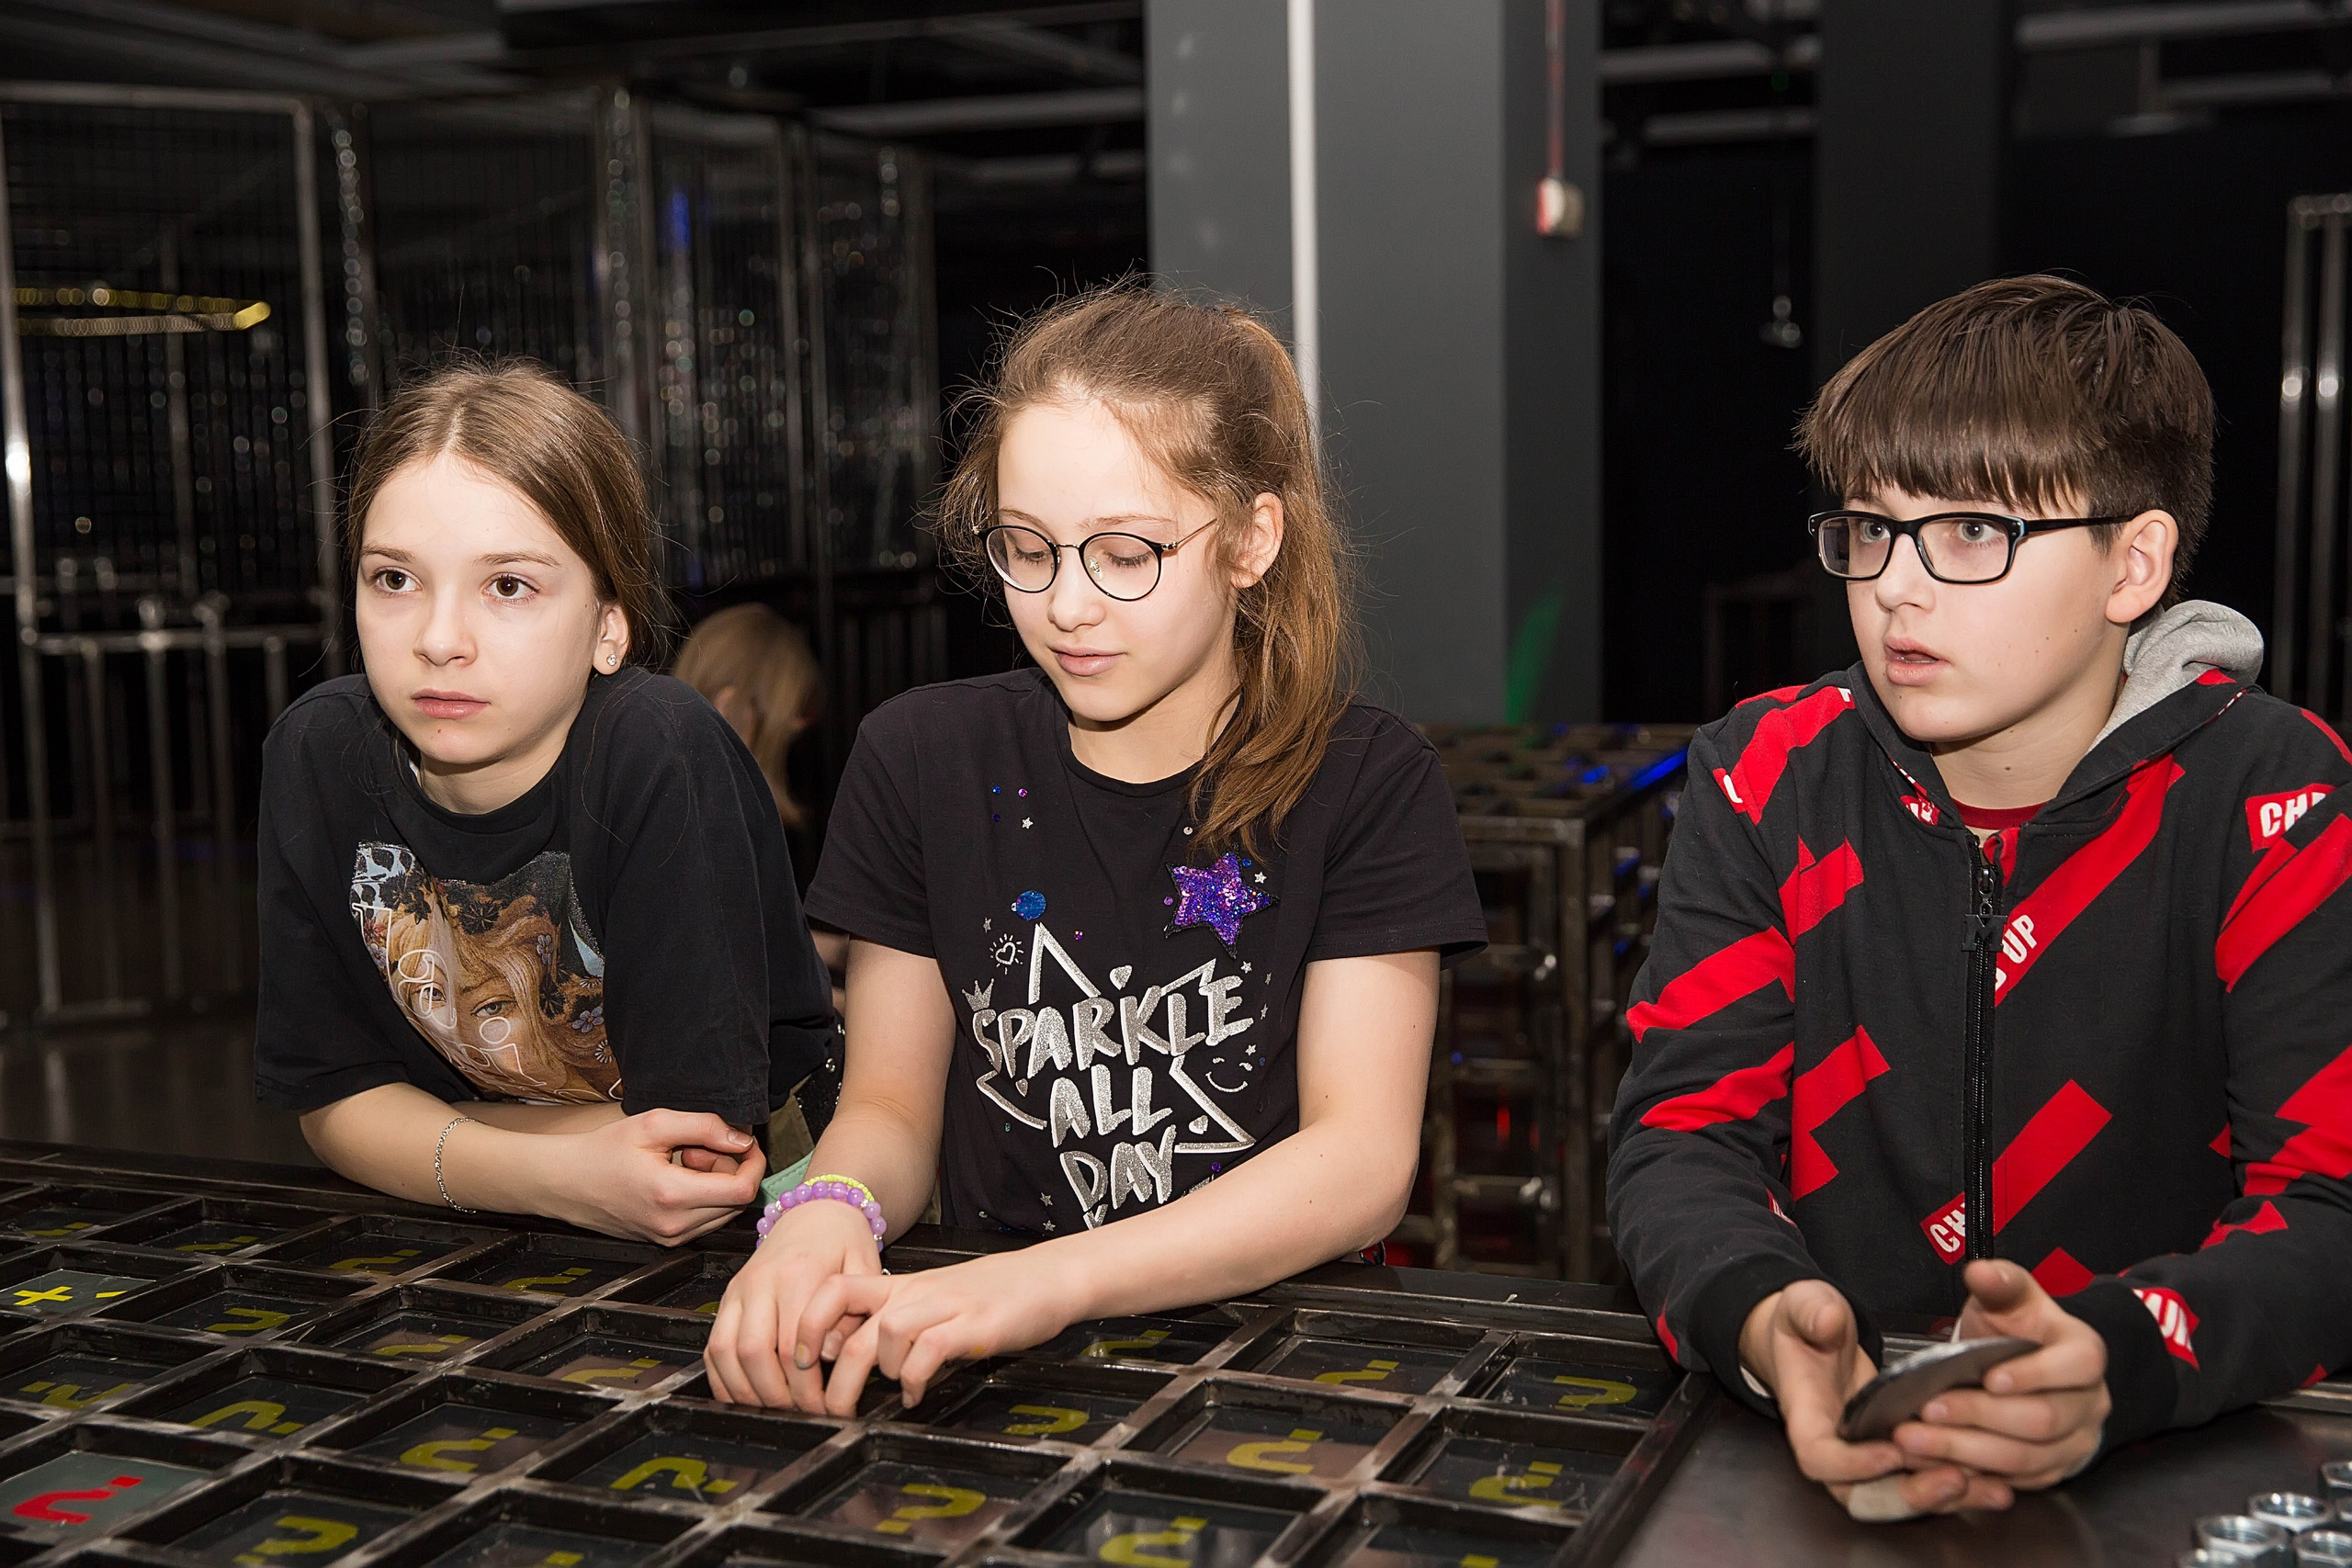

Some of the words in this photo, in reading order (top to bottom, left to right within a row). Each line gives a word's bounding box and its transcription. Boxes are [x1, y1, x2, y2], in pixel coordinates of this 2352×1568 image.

[2260, 792, 2326, 838] CH
[1995, 915, 2038, 991] UP
[972, 976, 1254, 1080] SPARKLE
[1051, 1065, 1172, 1148] ALL
[1059, 1125, 1176, 1213] DAY
[1930, 1202, 1965, 1253] CH
